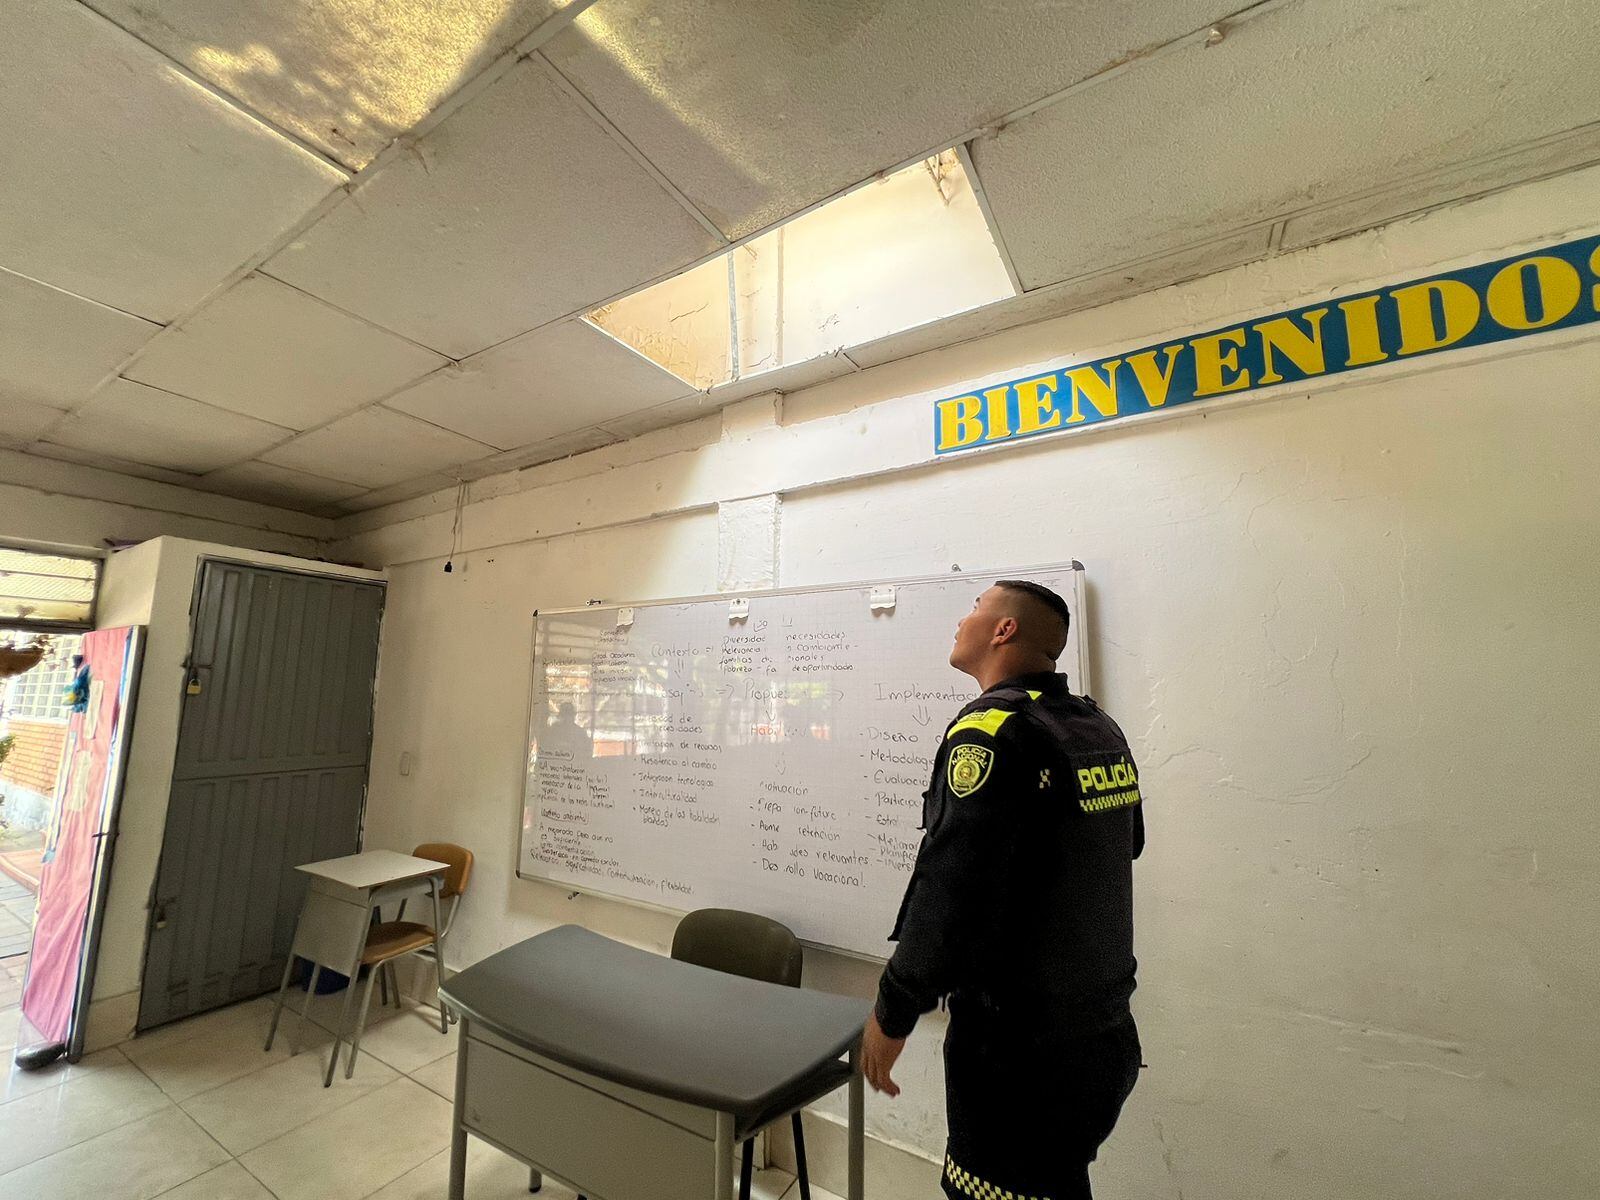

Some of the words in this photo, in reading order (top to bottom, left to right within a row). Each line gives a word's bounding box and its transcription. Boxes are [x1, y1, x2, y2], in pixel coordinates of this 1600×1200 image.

[938, 240, 1600, 450] BIENVENIDO
[651, 642, 699, 658] Contexto
[874, 681, 978, 702] Implementaci
[867, 727, 919, 743] Diseño
[1077, 755, 1138, 793] POLICÍA
